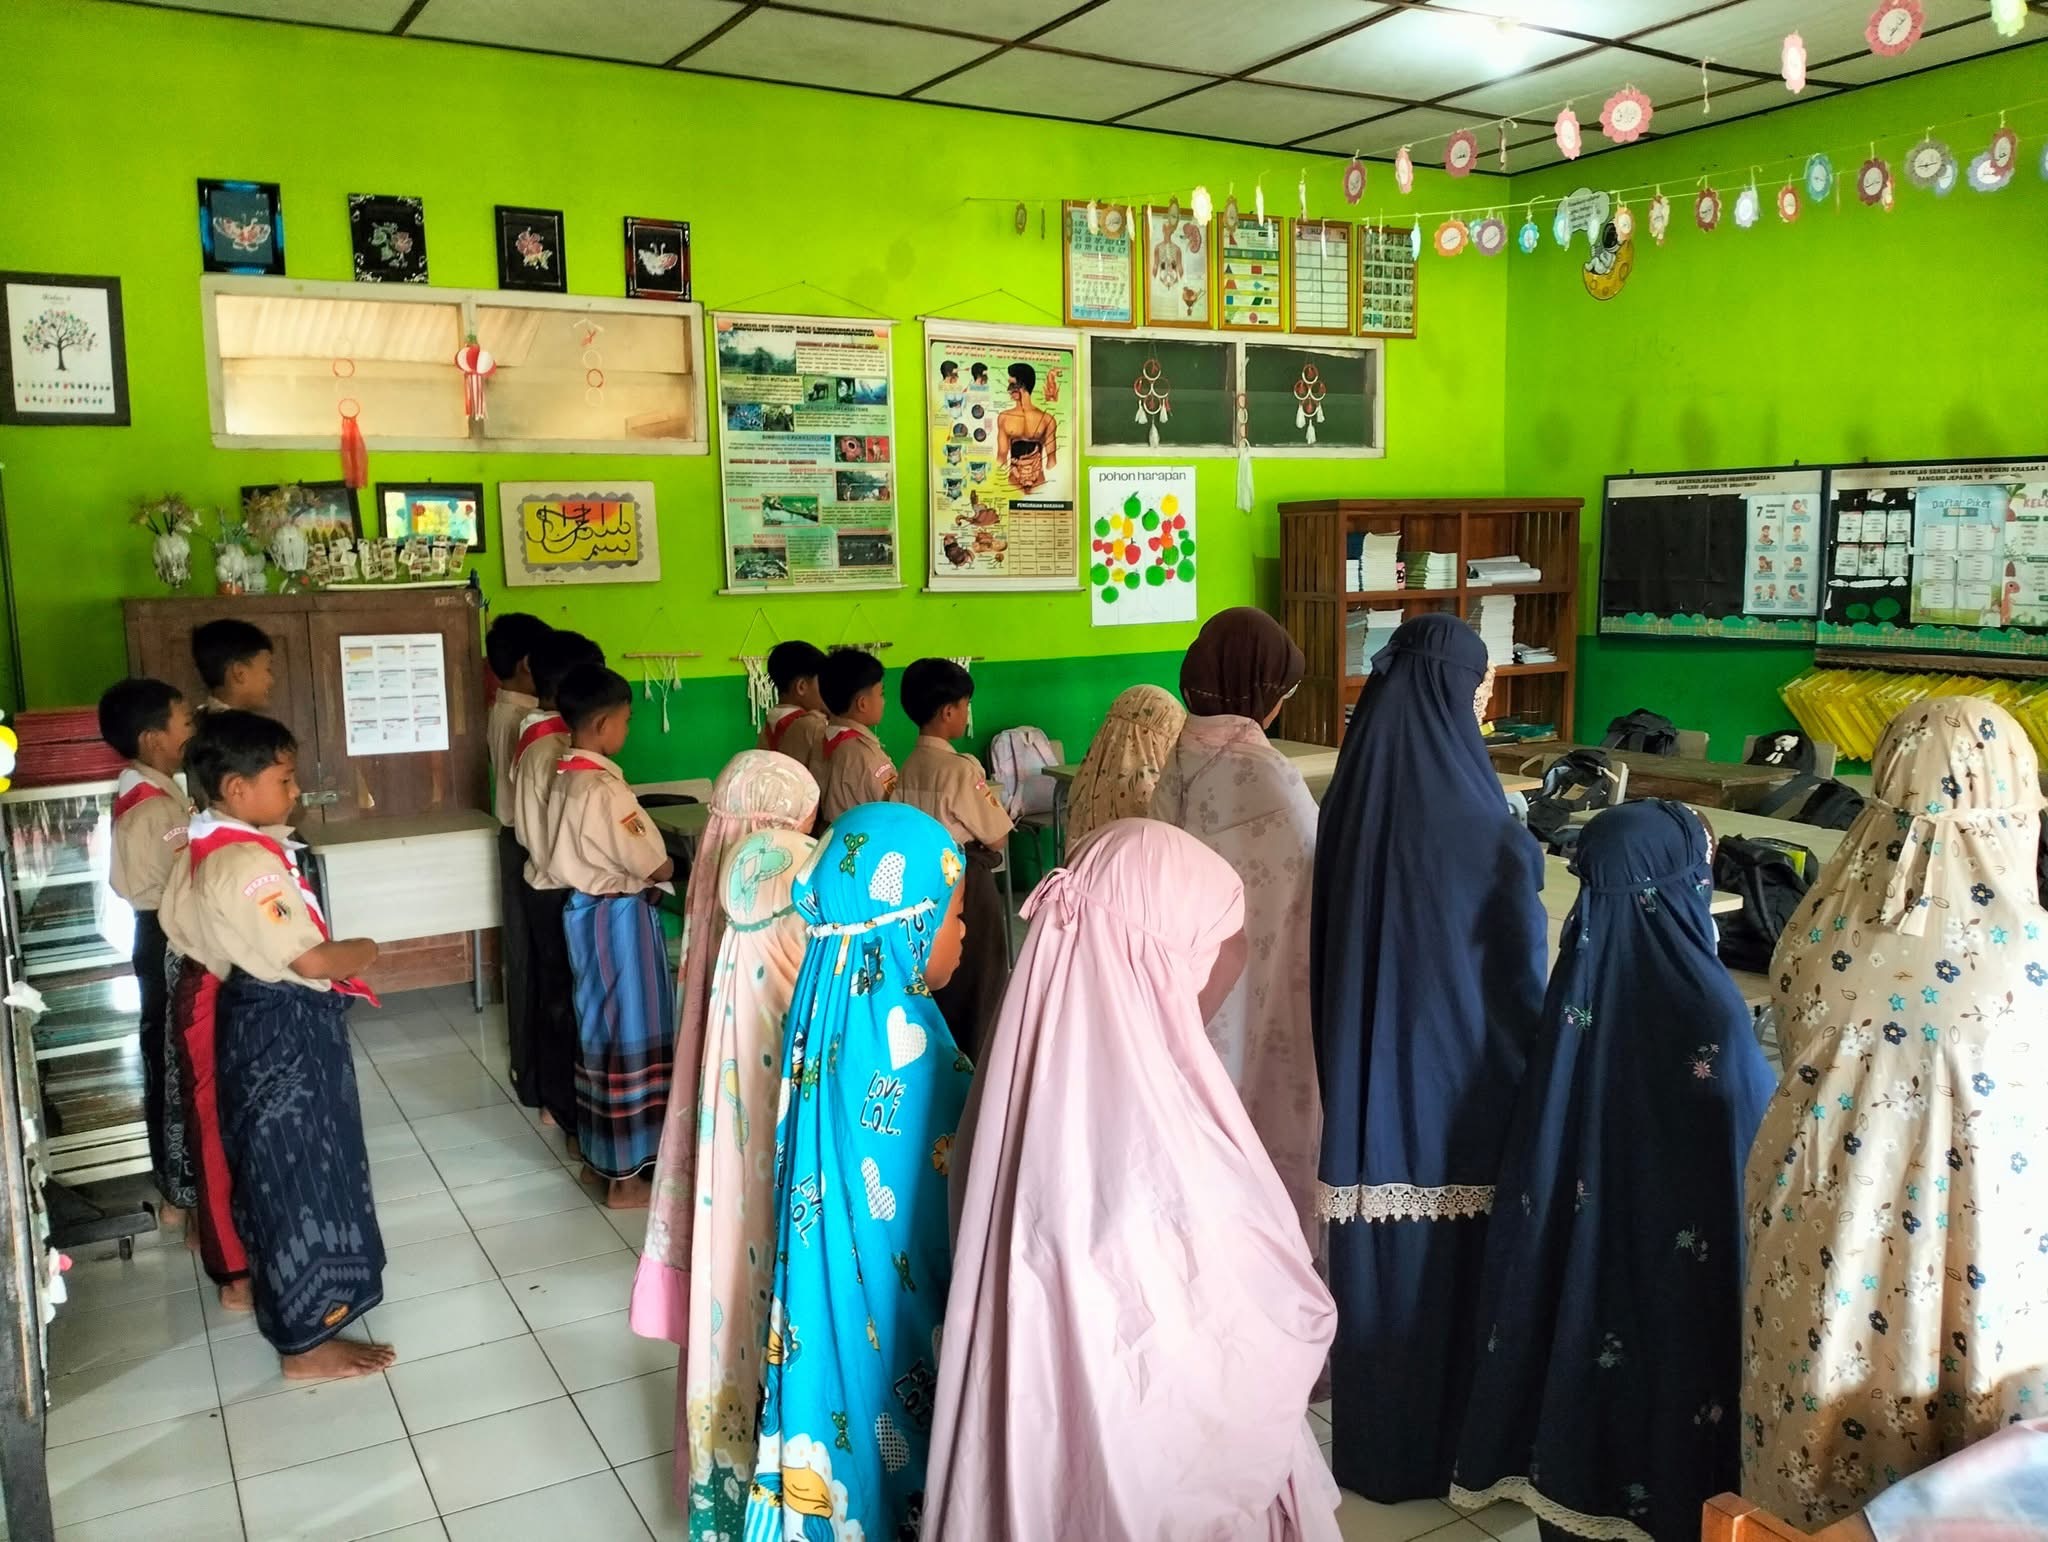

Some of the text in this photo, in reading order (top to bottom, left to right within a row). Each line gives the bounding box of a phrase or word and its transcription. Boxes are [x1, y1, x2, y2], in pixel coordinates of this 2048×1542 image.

[1098, 471, 1187, 482] pohon harapan
[1932, 498, 1991, 509] Daftar Piket
[1756, 506, 1763, 518] 7
[868, 1071, 906, 1106] LOVE
[859, 1101, 901, 1136] L.O.L.
